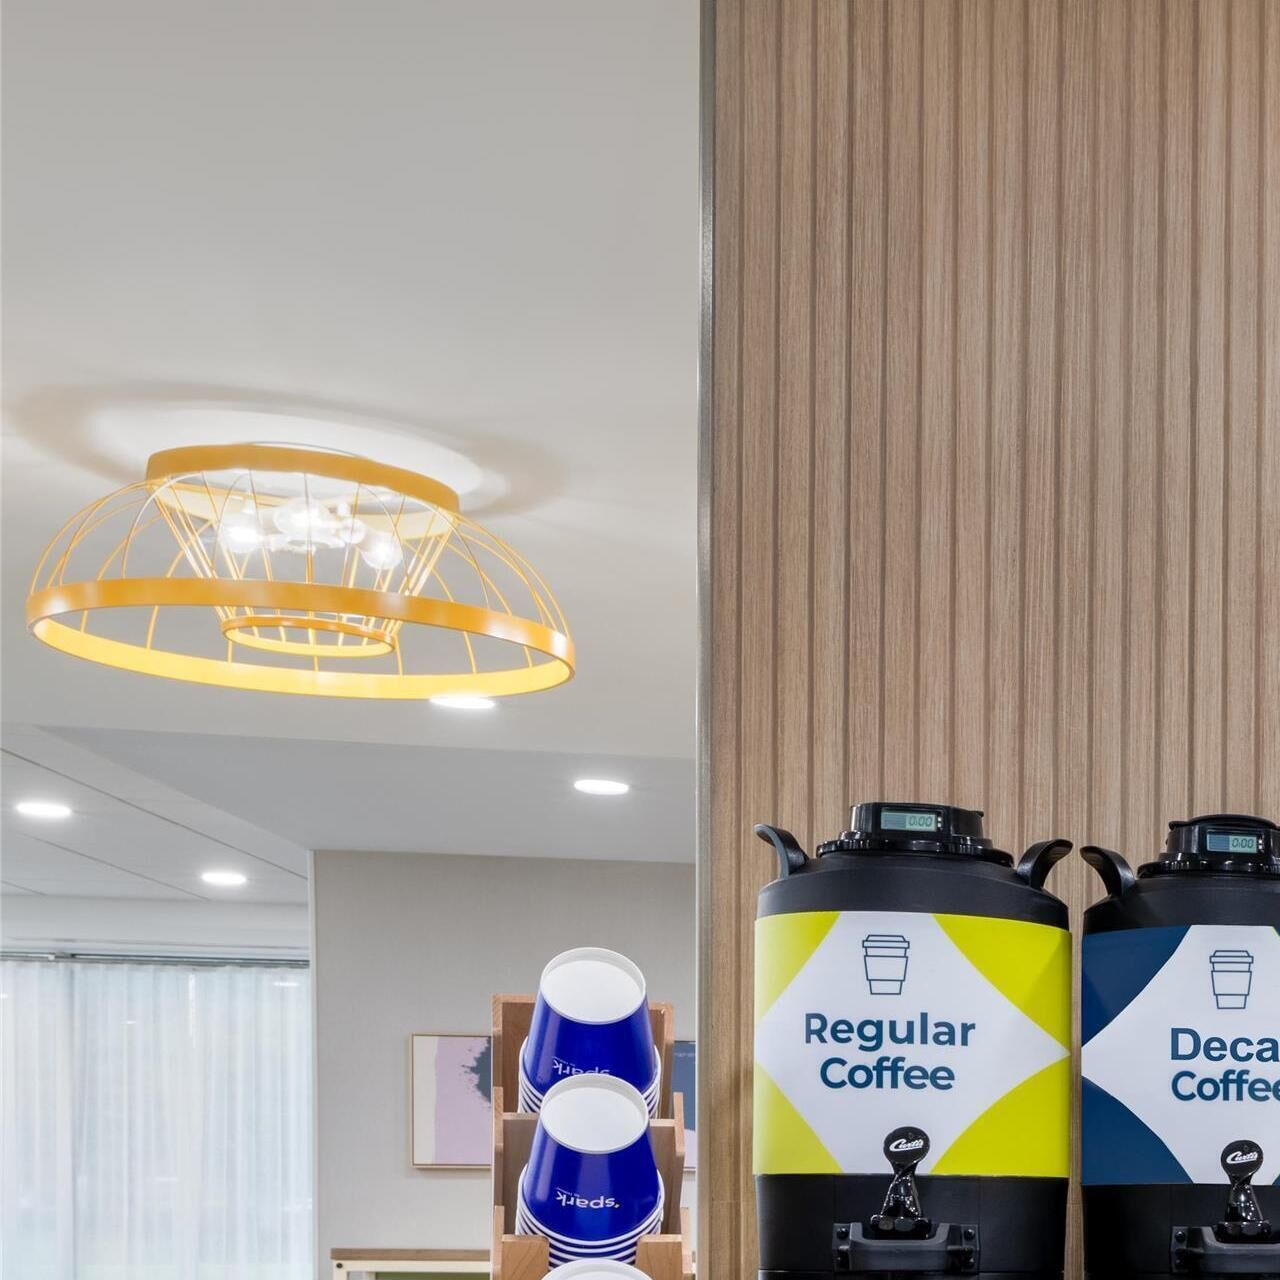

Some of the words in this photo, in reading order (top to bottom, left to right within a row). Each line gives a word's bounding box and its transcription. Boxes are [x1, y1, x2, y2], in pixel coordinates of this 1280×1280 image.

[1231, 838, 1254, 849] 0:00
[805, 1012, 976, 1052] Regular
[820, 1056, 955, 1090] Coffee
[556, 1191, 615, 1208] spark
